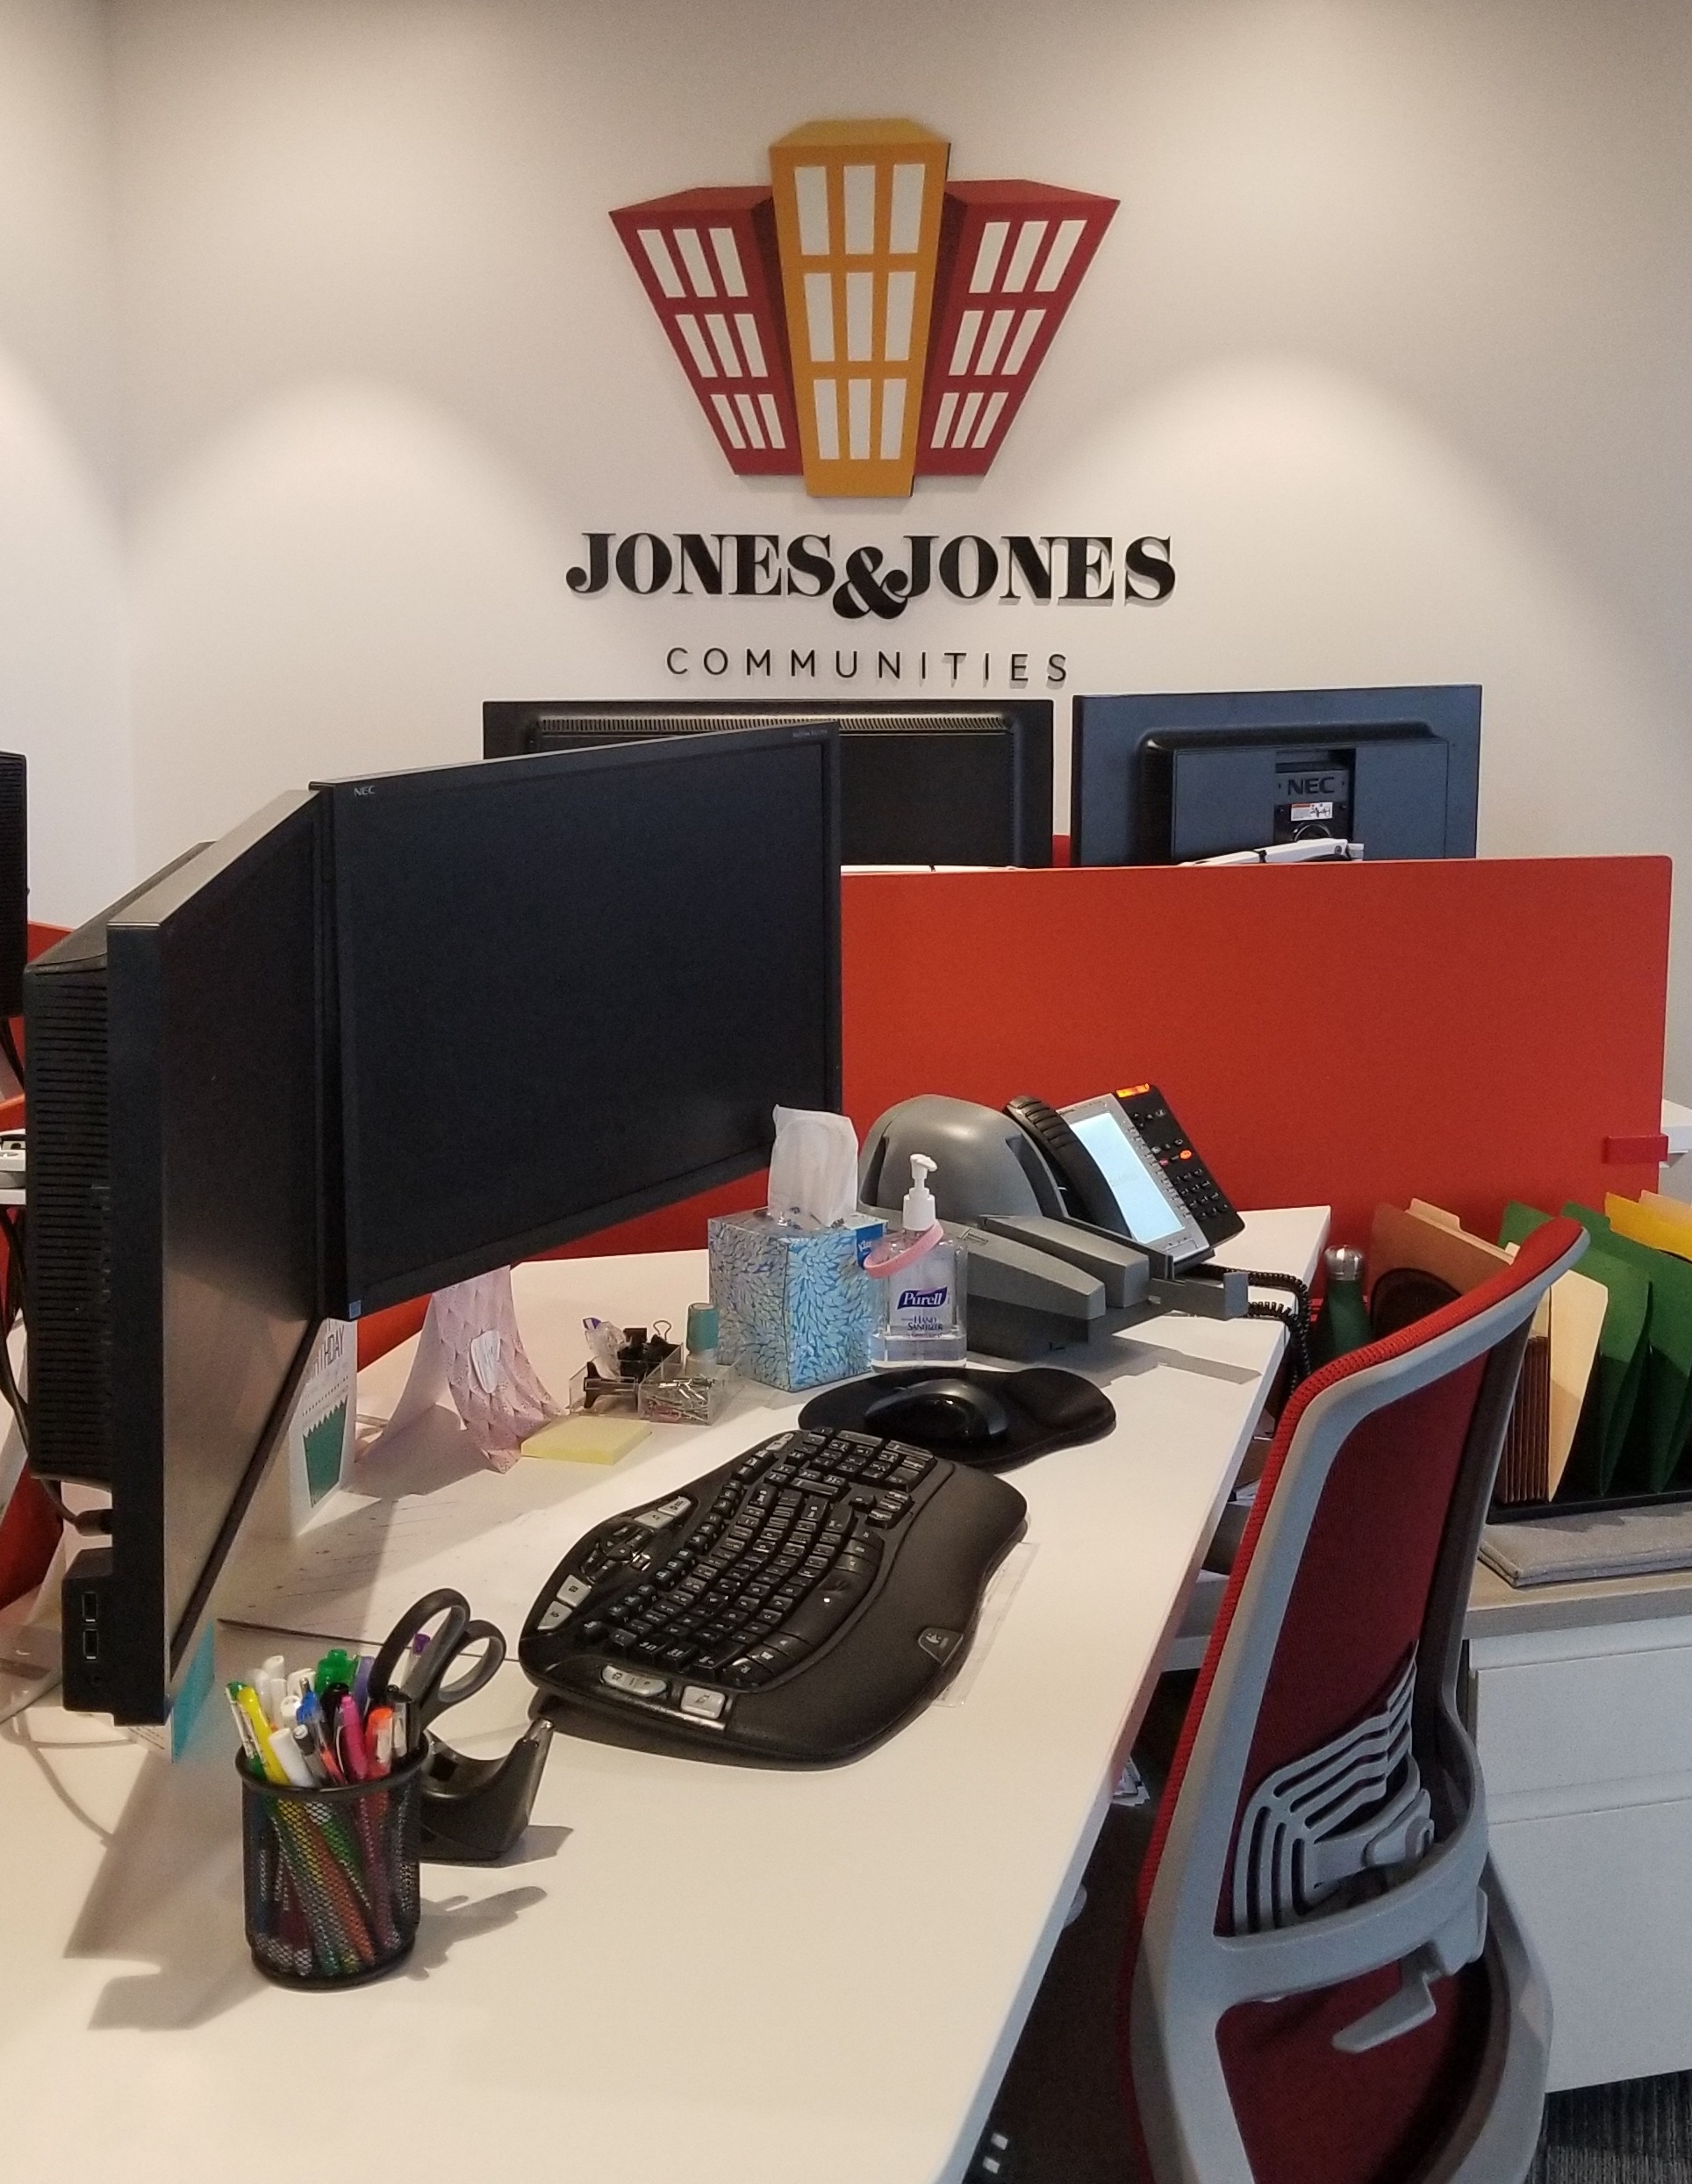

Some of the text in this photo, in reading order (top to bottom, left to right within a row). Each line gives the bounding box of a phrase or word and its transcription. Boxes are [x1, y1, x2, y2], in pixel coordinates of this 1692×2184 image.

[566, 532, 1176, 620] JONES&JONES
[666, 647, 1068, 683] COMMUNITIES
[354, 785, 376, 797] NEC
[1287, 777, 1335, 795] NEC
